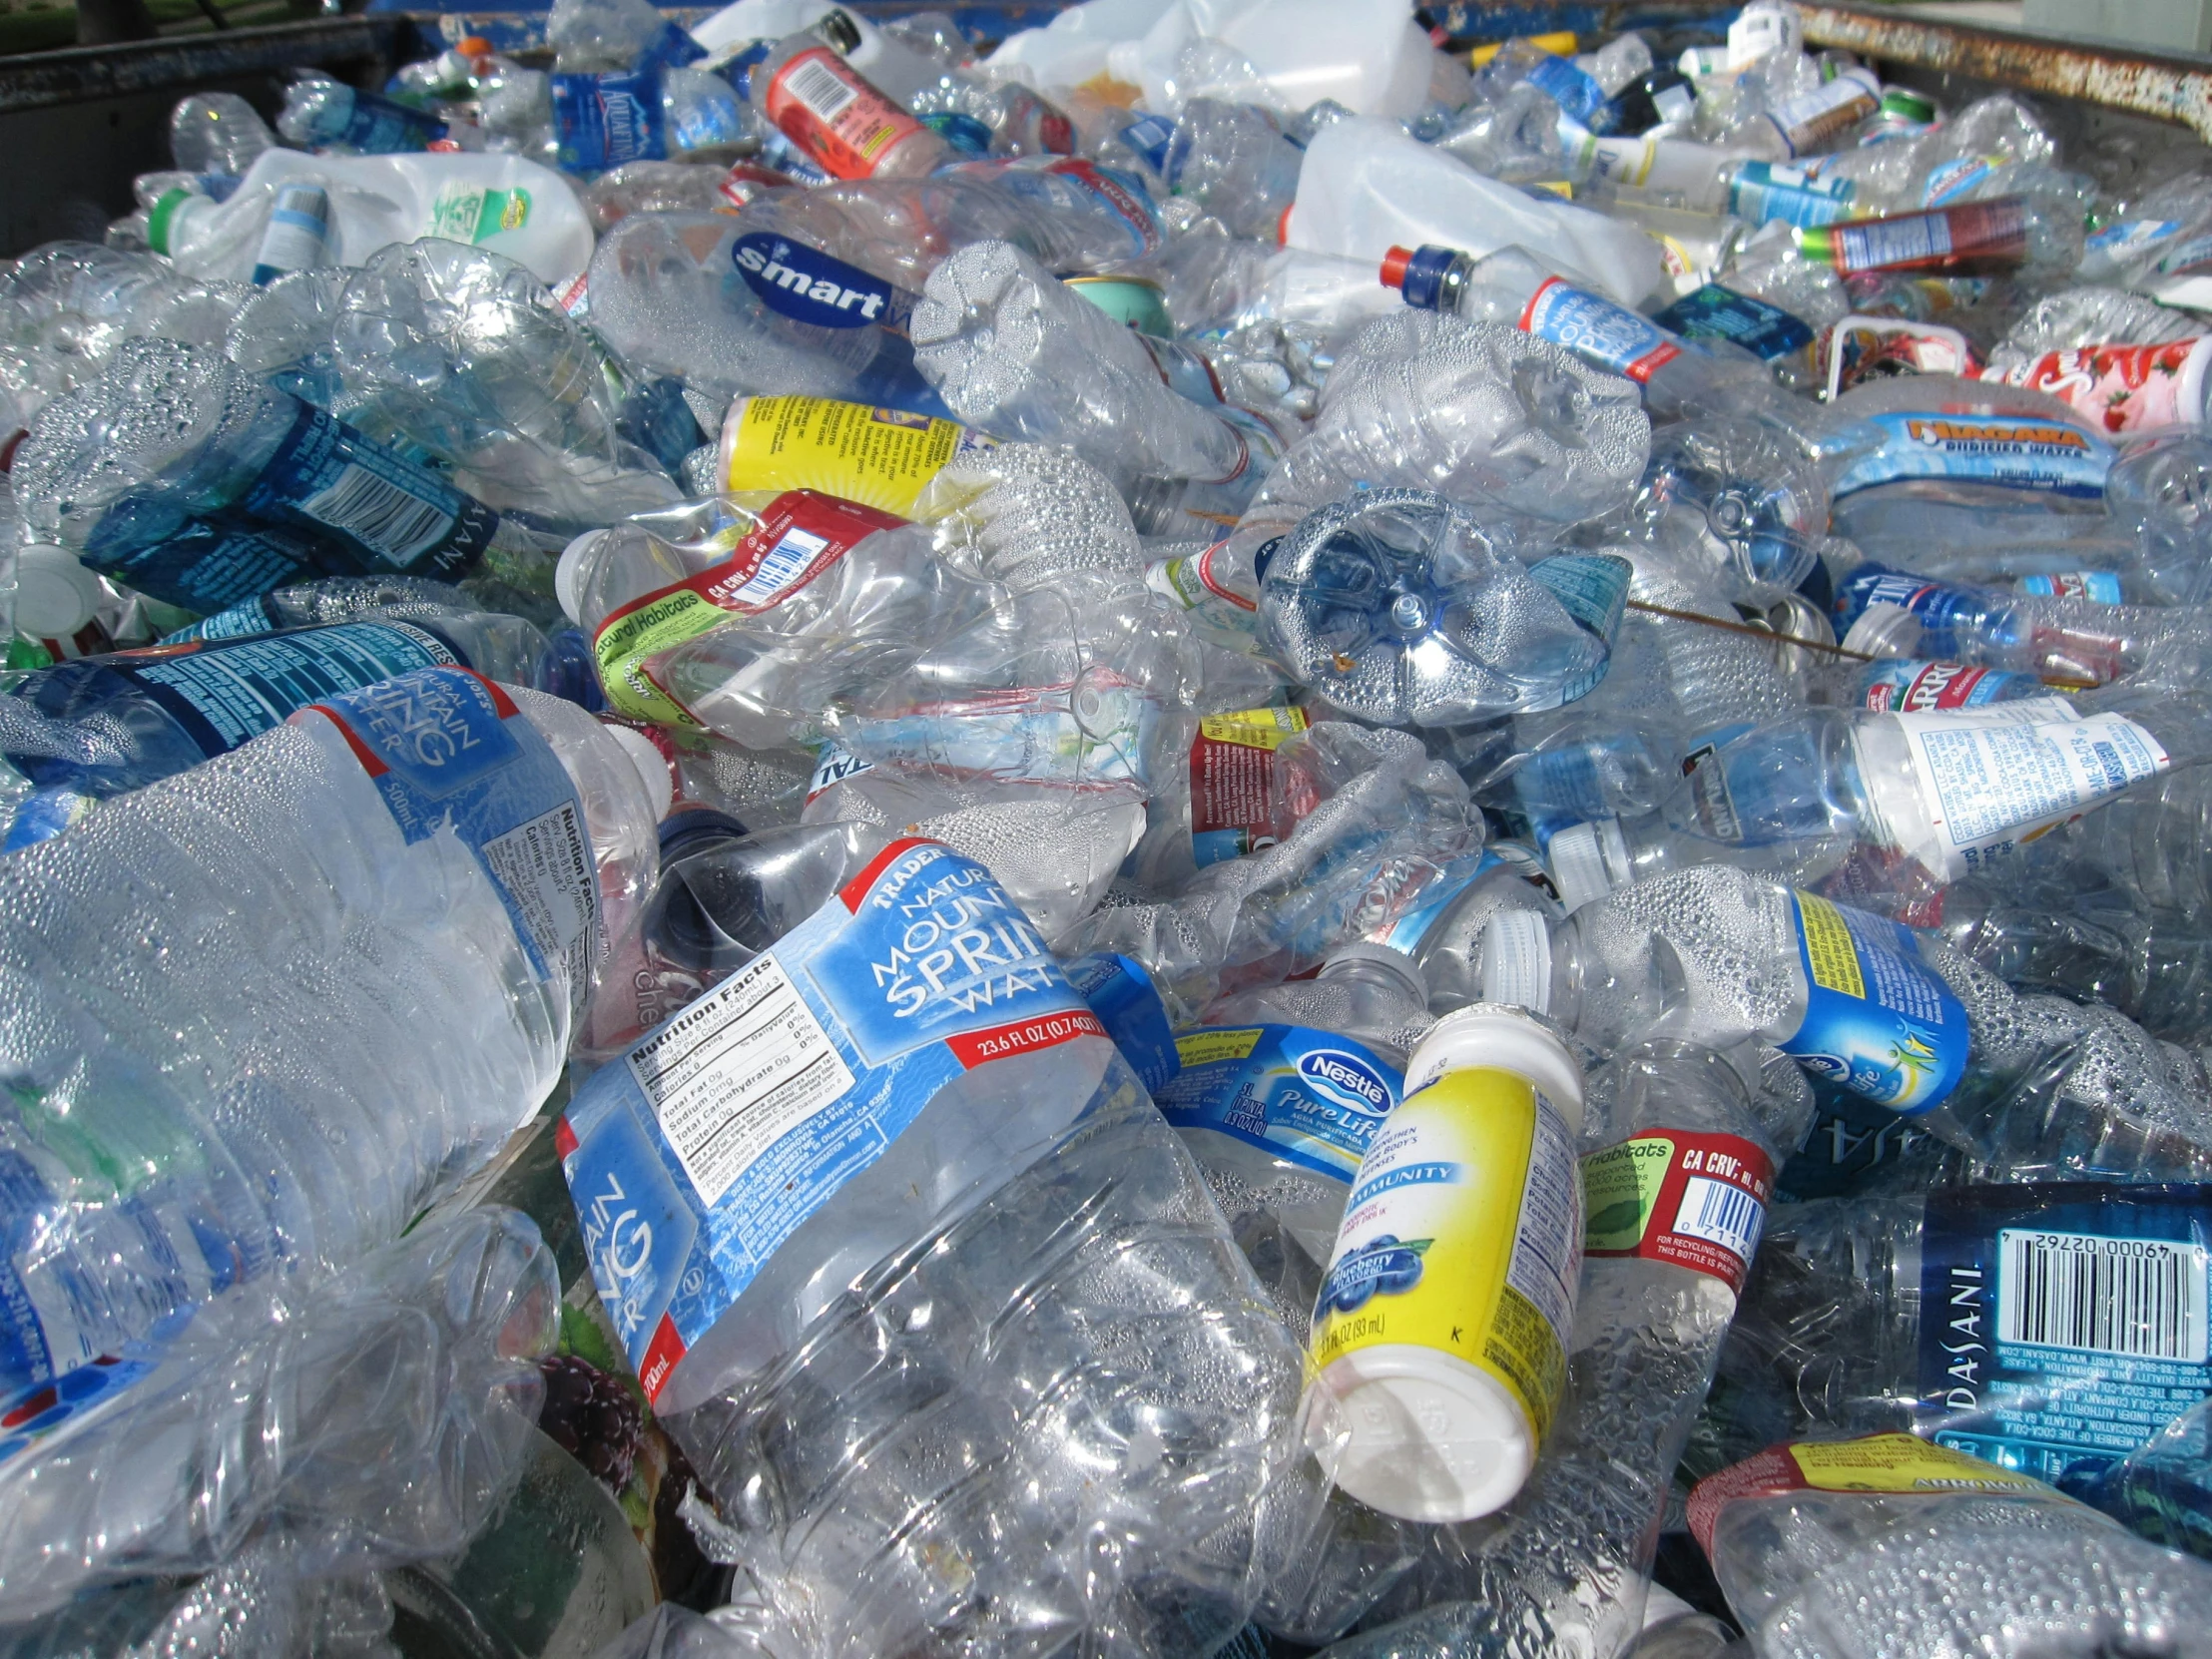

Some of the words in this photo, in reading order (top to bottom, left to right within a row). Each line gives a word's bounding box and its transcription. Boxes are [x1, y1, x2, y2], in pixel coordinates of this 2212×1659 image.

[736, 247, 884, 319] smart
[880, 428, 893, 455] digestive
[914, 434, 924, 452] About
[1907, 420, 2091, 450] NIAGARA
[868, 445, 878, 467] where
[899, 446, 911, 474] immune
[707, 583, 729, 599] CA
[637, 592, 699, 634] Habitats
[383, 782, 417, 830] 500mL
[525, 826, 545, 868] Calories
[538, 820, 554, 859] Servings
[547, 859, 563, 886] about
[556, 837, 568, 857] Size
[564, 873, 573, 885] oz
[560, 807, 587, 875] Nutrition
[580, 876, 597, 919] Facts
[872, 848, 946, 909] TRADER
[630, 998, 717, 1064] Nutrition
[719, 957, 773, 1002] Facts
[636, 1043, 674, 1073] Serving
[673, 1028, 694, 1046] Size
[694, 1023, 702, 1032] 8
[701, 1016, 711, 1026] fl
[712, 1009, 724, 1020] oz
[724, 978, 764, 1011] (240mL)
[786, 1011, 806, 1029] 0%
[640, 1046, 684, 1081] Servings
[683, 1033, 702, 1050] Per
[700, 1002, 746, 1037] Container
[744, 983, 770, 1004] about
[771, 975, 780, 984] 3
[793, 1021, 813, 1039] 0%
[799, 1031, 819, 1049] 0%
[977, 1036, 1008, 1055] 23.6
[1010, 1028, 1025, 1046] FL
[1026, 1024, 1046, 1042] OZ
[647, 1066, 680, 1092] Amount
[679, 1056, 693, 1069] Per
[693, 1032, 724, 1058] Serving
[652, 1067, 694, 1102] Calories
[693, 1061, 701, 1070] 0
[661, 1095, 689, 1119] Total
[689, 1079, 709, 1097] Fat
[707, 1068, 724, 1084] 0g
[667, 1095, 710, 1131] Sodium
[707, 1075, 734, 1099] 0mg
[675, 1118, 702, 1143] Total
[701, 1063, 775, 1120] Carbohydrate
[774, 1052, 791, 1068] 0g
[1278, 1089, 1338, 1122] Pure
[680, 1119, 722, 1155] Protein
[717, 1105, 735, 1121] 0g
[1383, 1136, 1418, 1157] BODY'S
[1589, 1142, 1667, 1165] Habitats
[1586, 1163, 1645, 1180] supported
[1681, 1149, 1703, 1170] CA
[1706, 1152, 1742, 1180] CRV;
[1657, 1235, 1672, 1244] FOR
[1681, 1222, 1690, 1231] 0
[2001, 1232, 2010, 1243] 4
[2035, 1235, 2096, 1253] 02762
[2107, 1241, 2169, 1259] 49000
[1658, 1246, 1675, 1256] THIS
[1677, 1249, 1706, 1266] BOTTLE
[1707, 1256, 1716, 1268] IS
[1717, 1262, 1735, 1277] PART
[1450, 1326, 1463, 1344] K
[1937, 1268, 1988, 1410] DASANI
[2062, 1404, 2115, 1418] AUTHORITY
[2005, 1423, 2056, 1438] COCA-COLA
[2059, 1429, 2074, 1439] THE
[2077, 1431, 2091, 1441] OF
